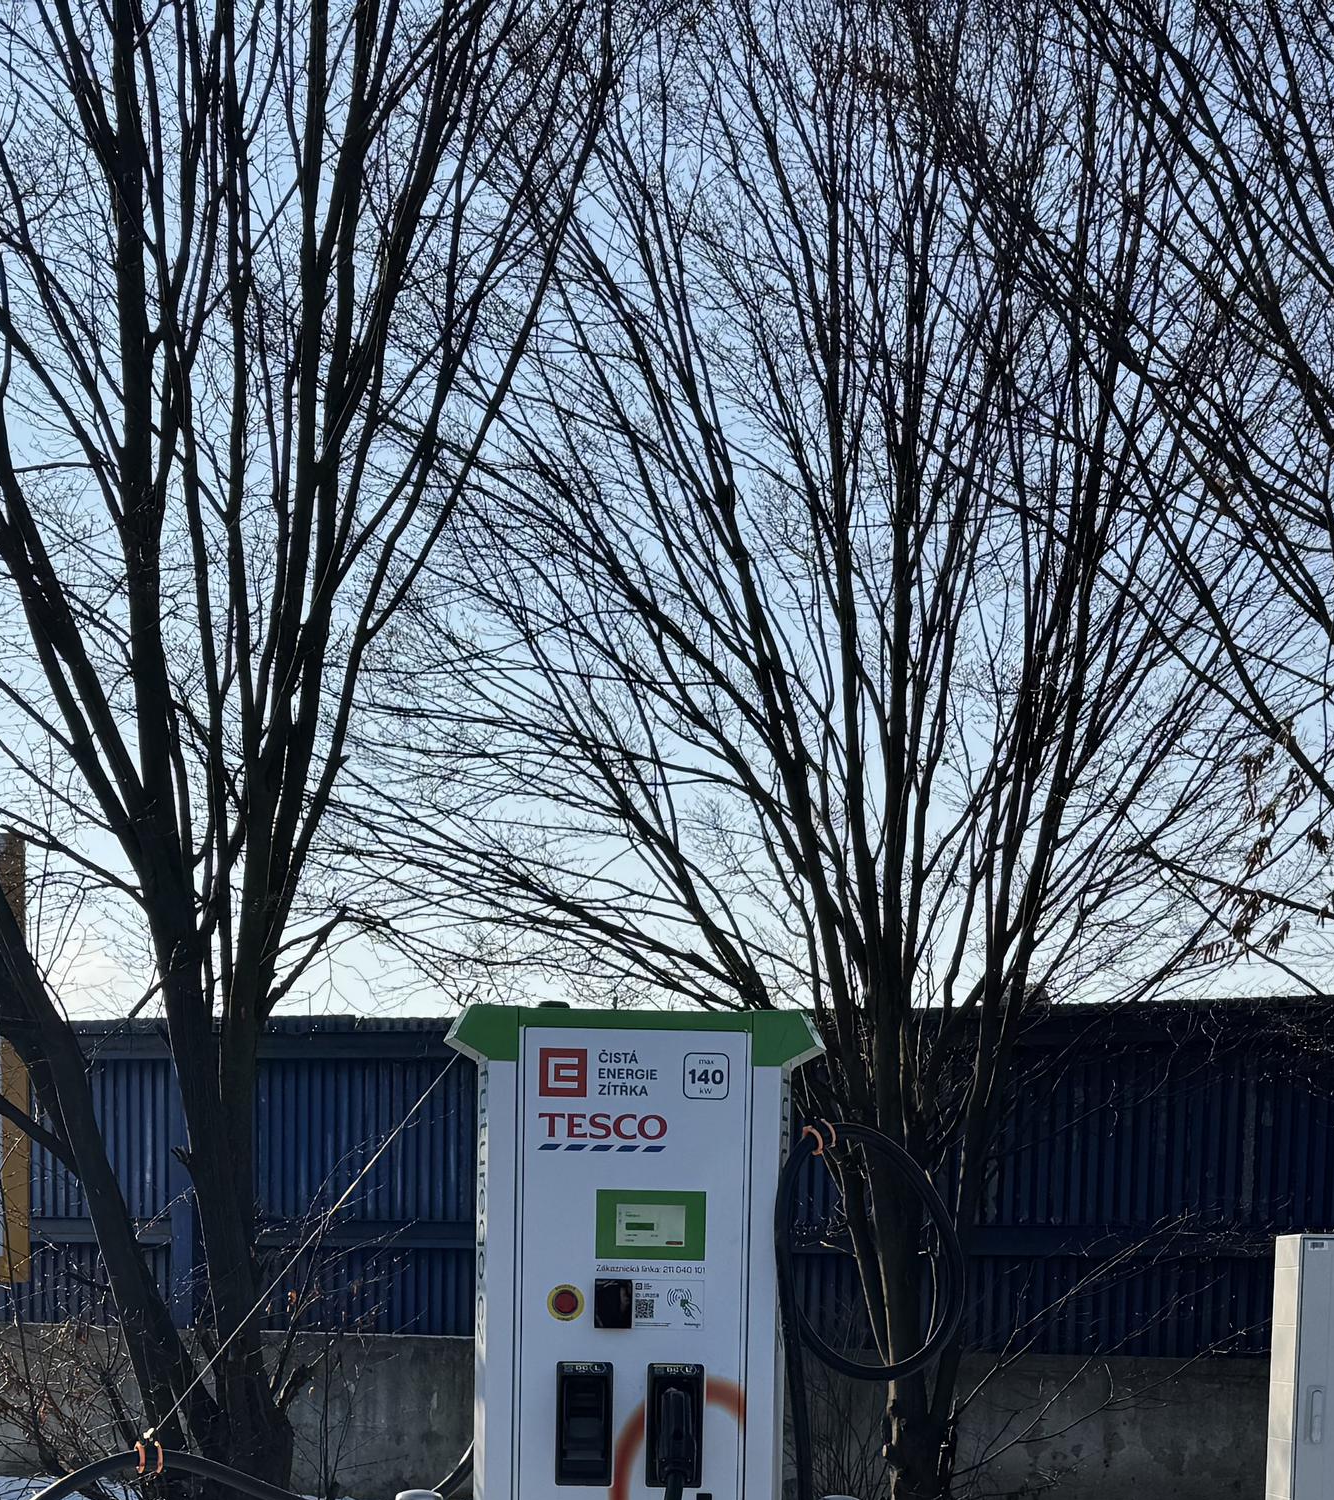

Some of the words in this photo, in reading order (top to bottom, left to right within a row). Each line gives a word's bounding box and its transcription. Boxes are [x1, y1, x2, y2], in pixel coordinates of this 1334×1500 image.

[598, 1050, 638, 1064] ČISTÁ
[598, 1068, 658, 1081] ENERGIE
[688, 1069, 725, 1086] 140
[598, 1083, 648, 1097] ZÍTŘKA
[699, 1087, 713, 1095] kW
[538, 1112, 668, 1140] TESCO
